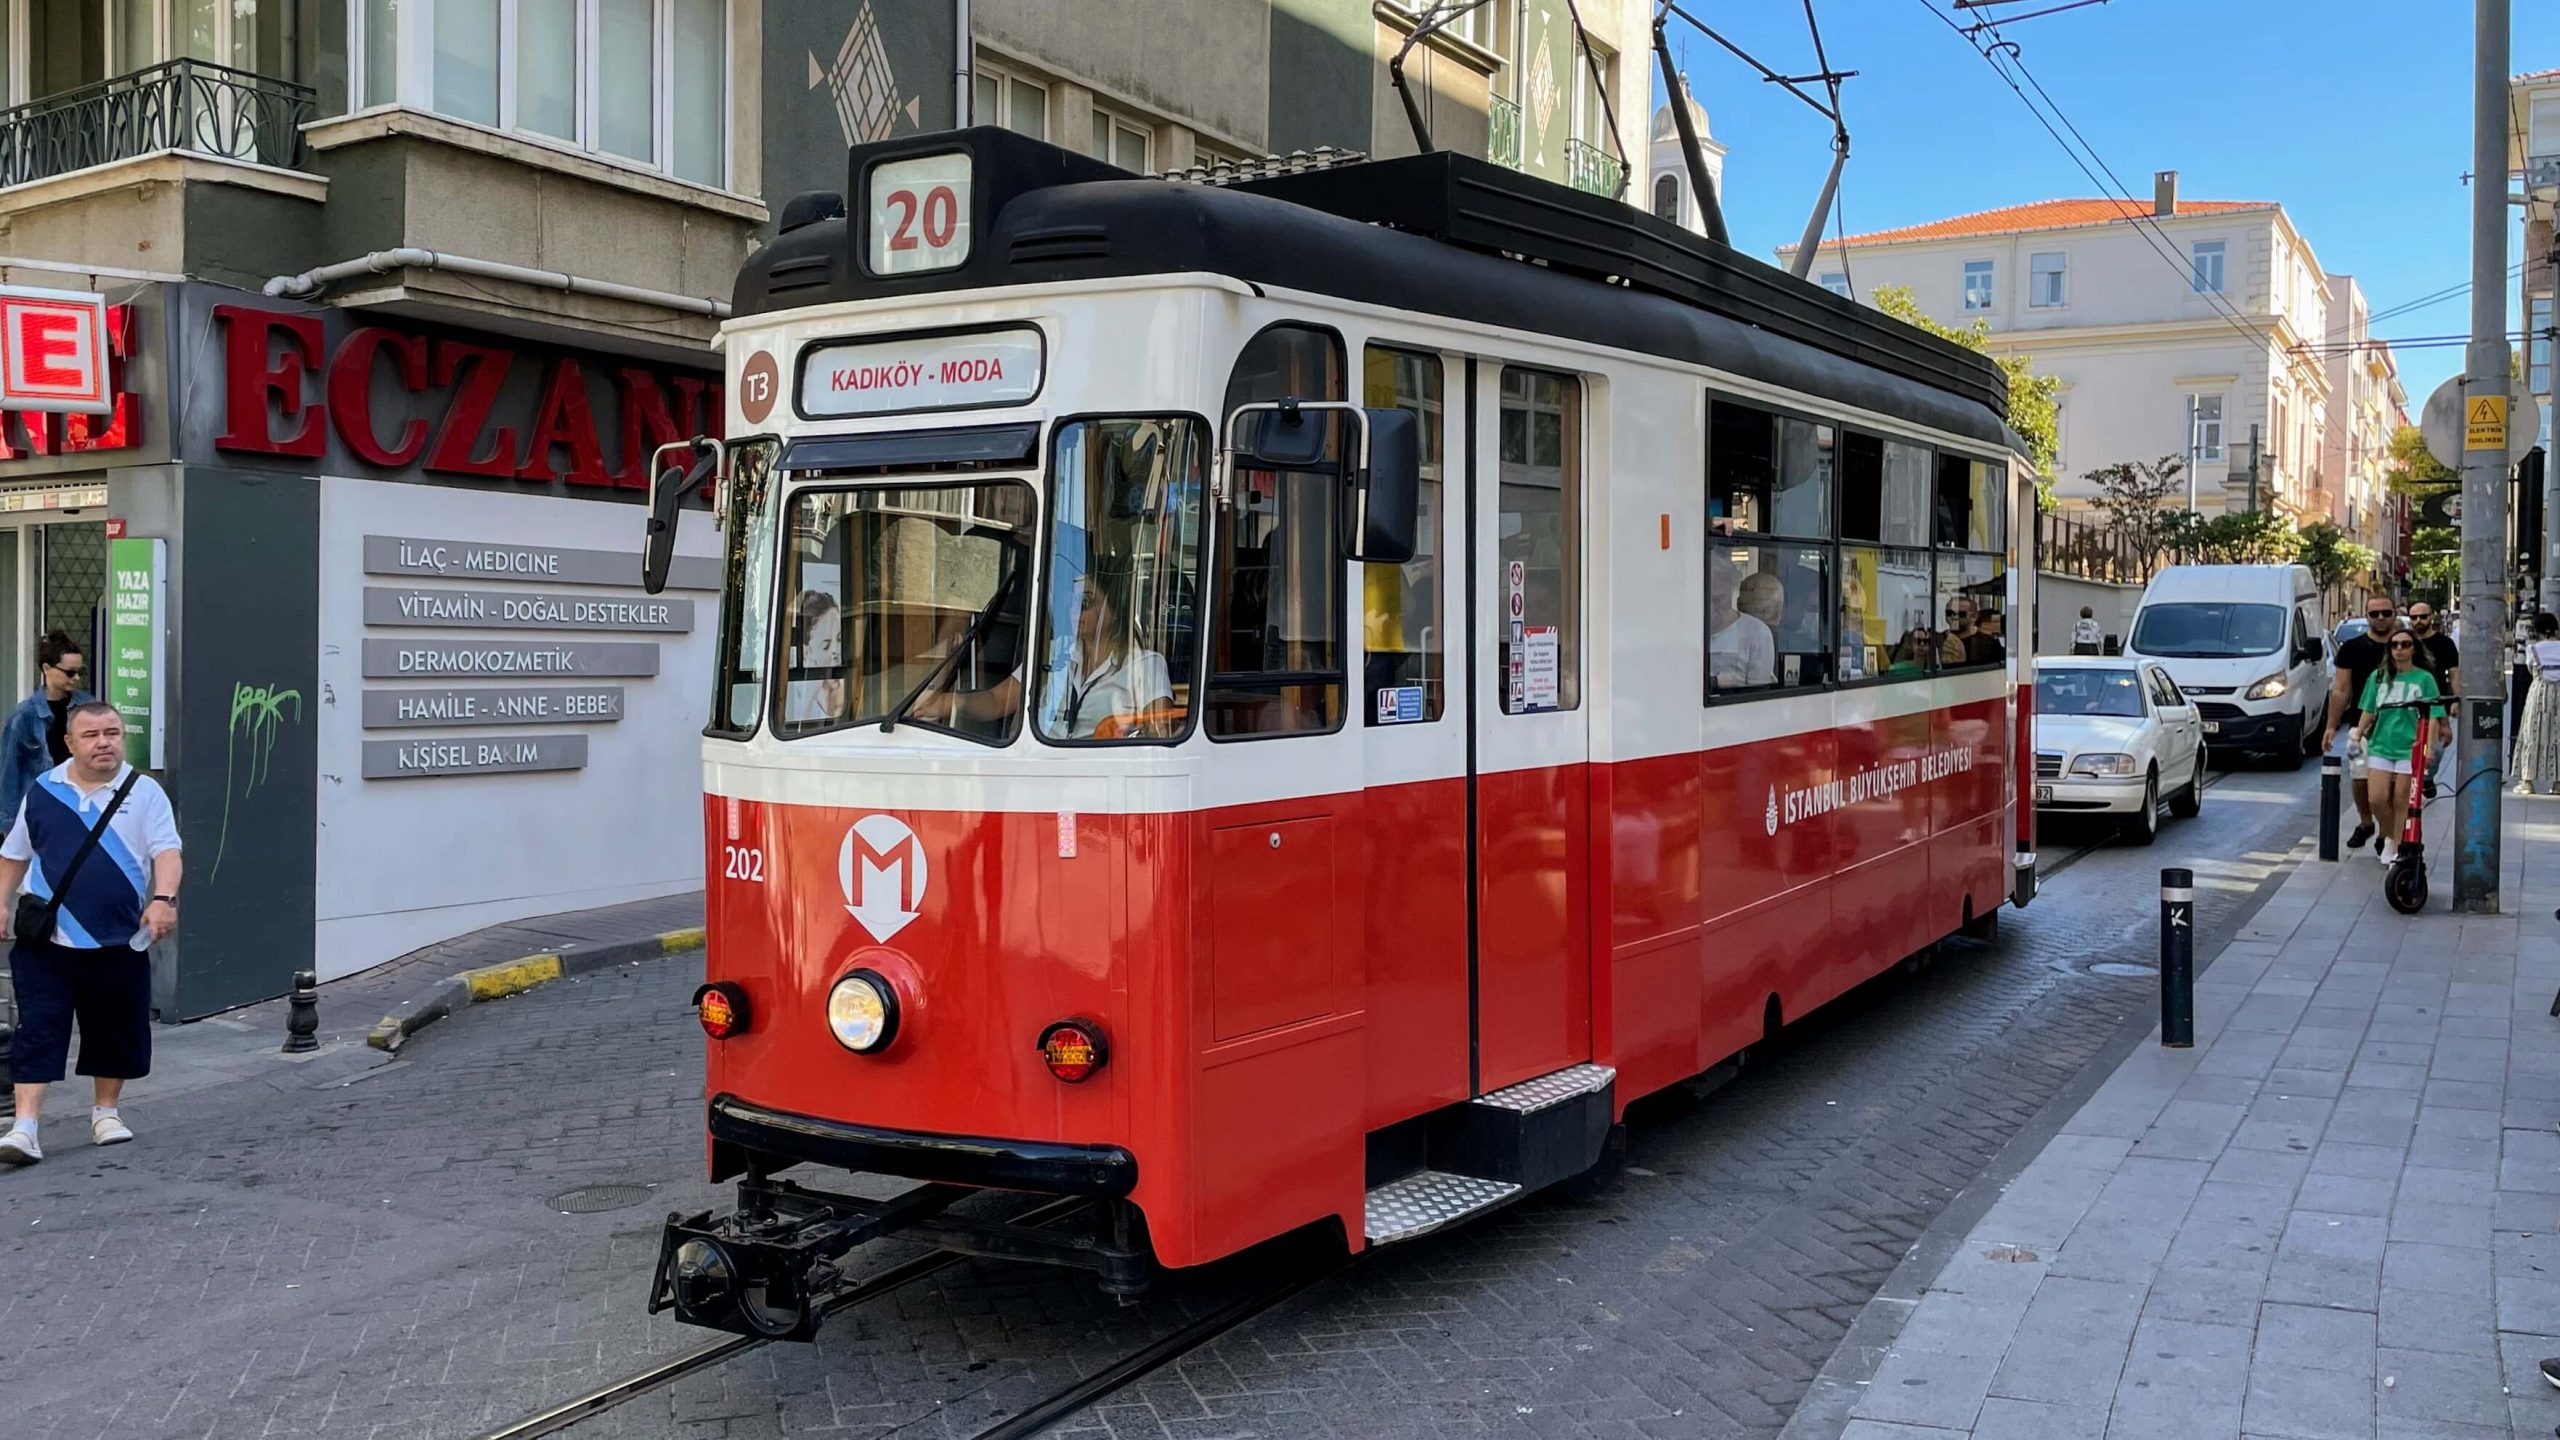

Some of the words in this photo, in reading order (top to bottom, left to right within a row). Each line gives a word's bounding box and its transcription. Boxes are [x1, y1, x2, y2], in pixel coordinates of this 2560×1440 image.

[887, 186, 957, 251] 20
[20, 312, 84, 388] E
[747, 371, 769, 403] T3
[832, 360, 923, 392] KADIKÖY
[941, 358, 1003, 385] MODA
[214, 304, 726, 498] ECZAN
[399, 540, 447, 574] İLAÇ
[465, 550, 559, 575] MEDICINE
[117, 571, 149, 590] YAZA
[116, 593, 149, 610] HAZIR
[398, 592, 484, 620] VİTAMİN
[503, 596, 570, 622] DOĞAL
[574, 602, 669, 625] DESTEKLER
[399, 647, 574, 672] DERMOKOZMETİK
[398, 692, 475, 720] HAMİLE
[493, 695, 548, 717] ANNE
[399, 741, 471, 773] KİŞİSEL
[1784, 779, 1846, 825] İSTANBUL
[1850, 754, 1917, 800] BÜYÜKŞEHİR
[1921, 739, 1972, 783] BELEDİYESİ
[725, 845, 763, 882] 202
